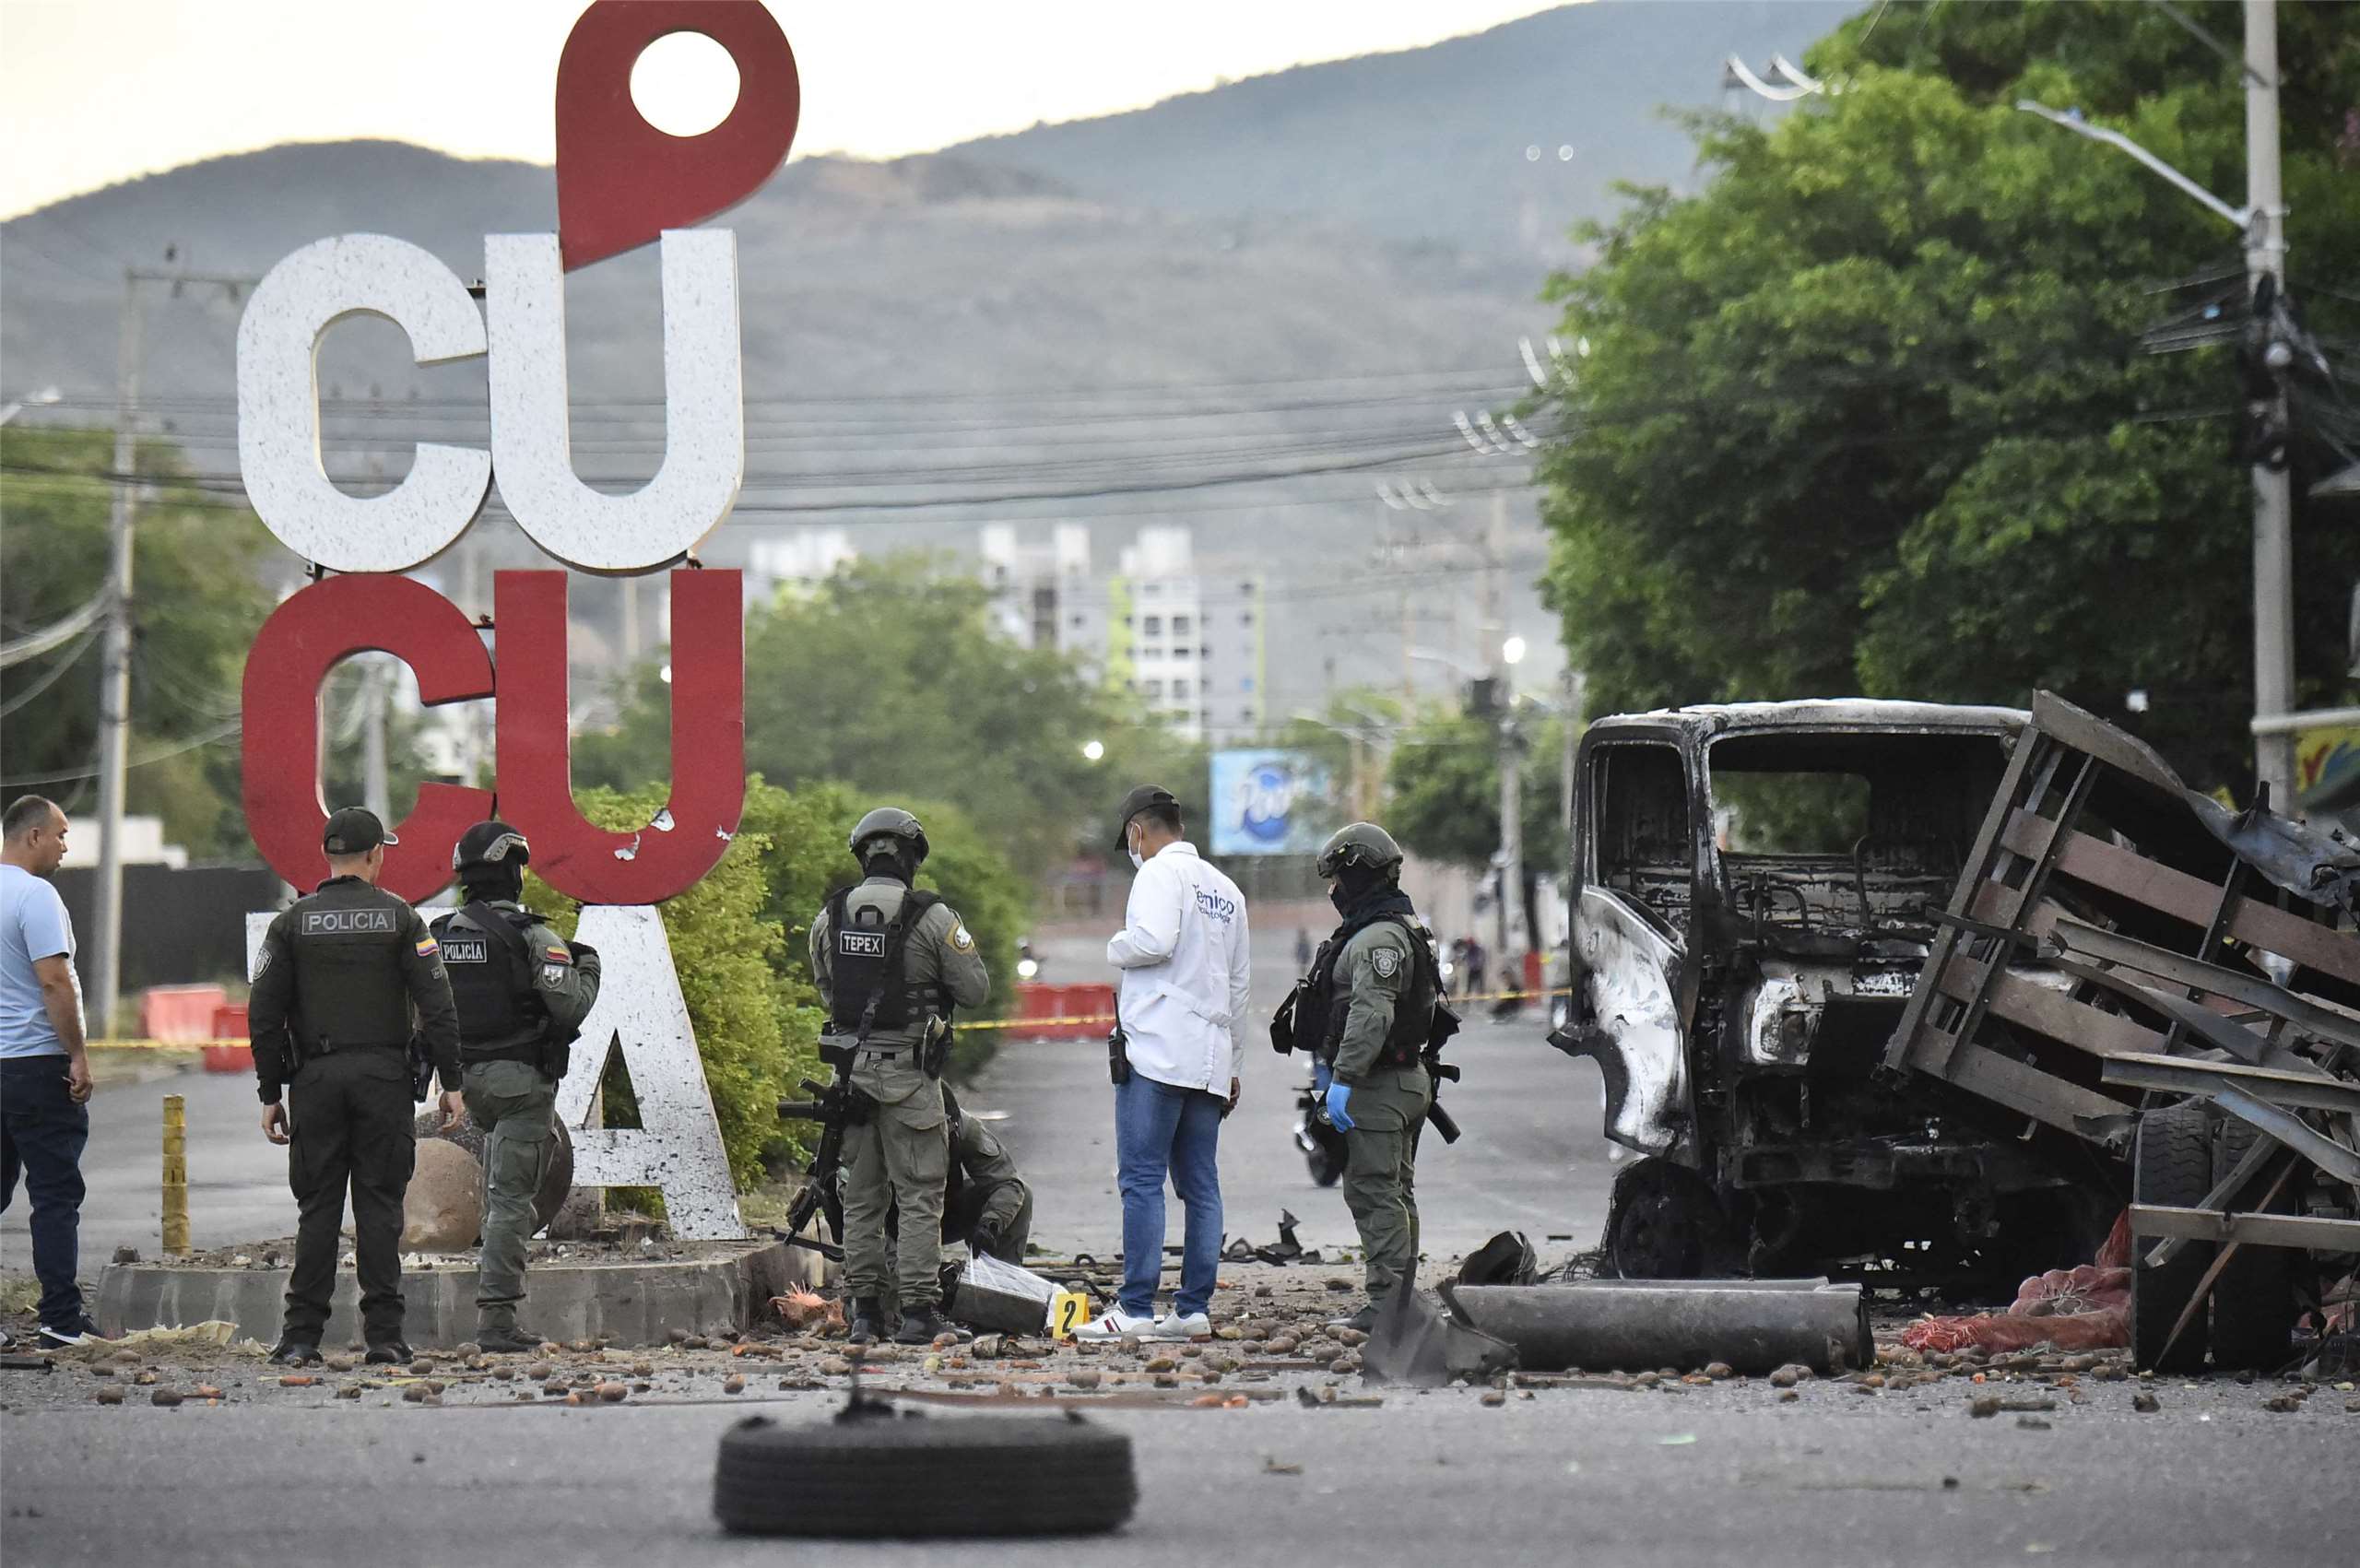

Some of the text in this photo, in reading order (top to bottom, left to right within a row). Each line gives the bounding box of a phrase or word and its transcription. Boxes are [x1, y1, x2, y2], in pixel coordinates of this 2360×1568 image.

[242, 569, 745, 906] CU
[308, 912, 388, 932] POLICIA
[843, 935, 880, 954] TEPEX
[1062, 1300, 1077, 1334] 2
